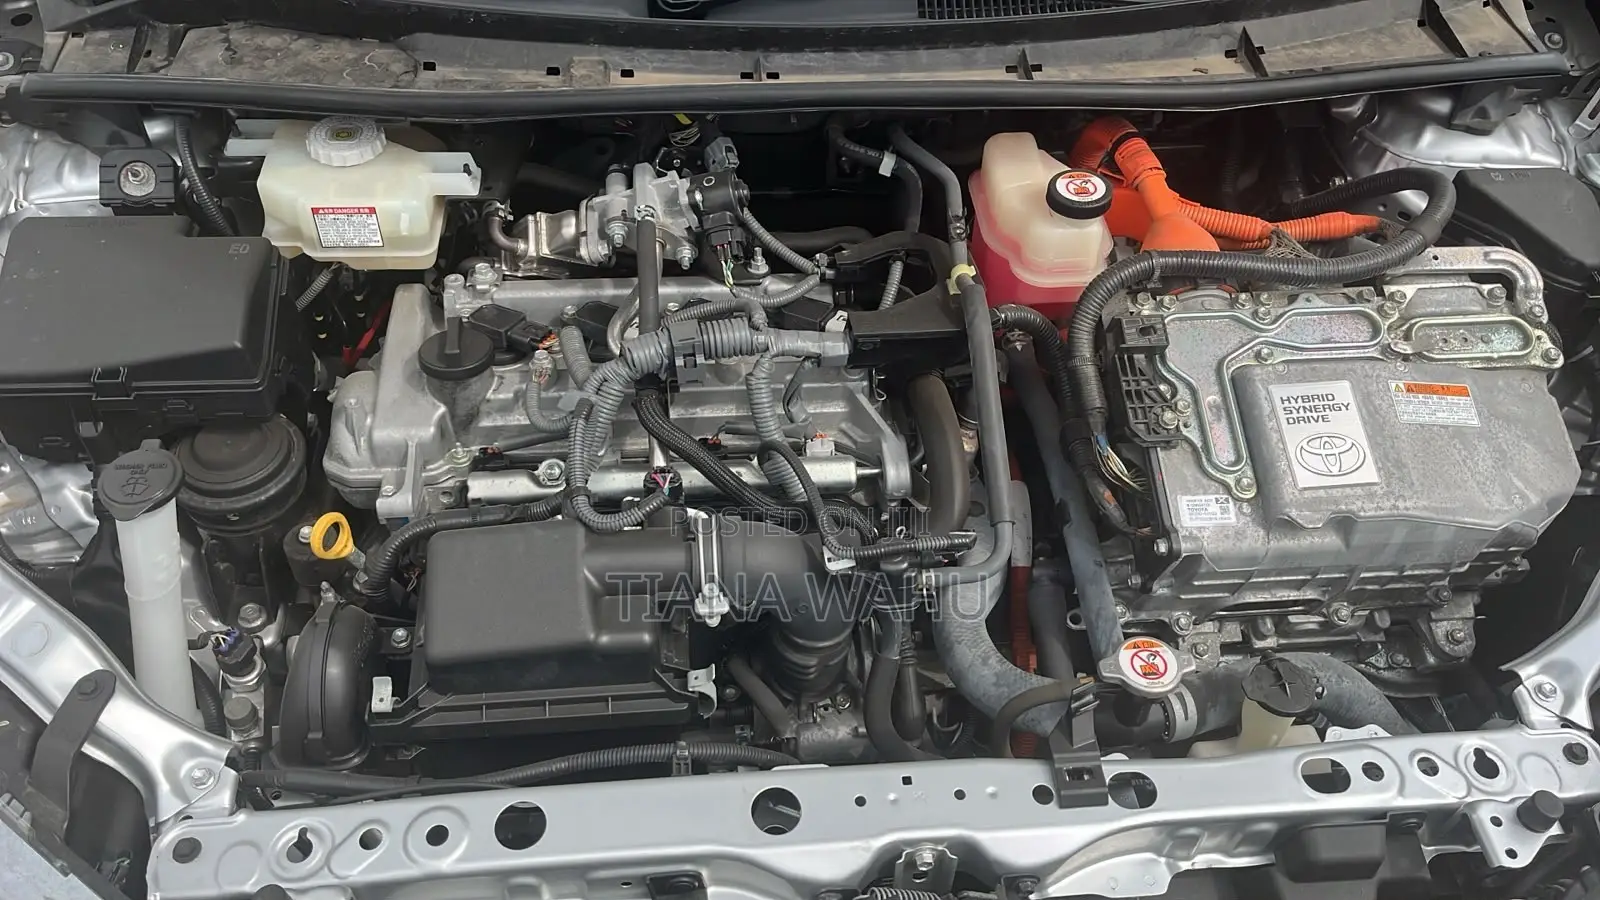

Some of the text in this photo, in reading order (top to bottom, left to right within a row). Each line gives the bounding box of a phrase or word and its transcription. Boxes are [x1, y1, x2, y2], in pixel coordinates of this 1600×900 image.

[1280, 393, 1336, 405] HYBRID
[1283, 402, 1351, 415] SYNERGY
[1286, 414, 1331, 425] DRIVE
